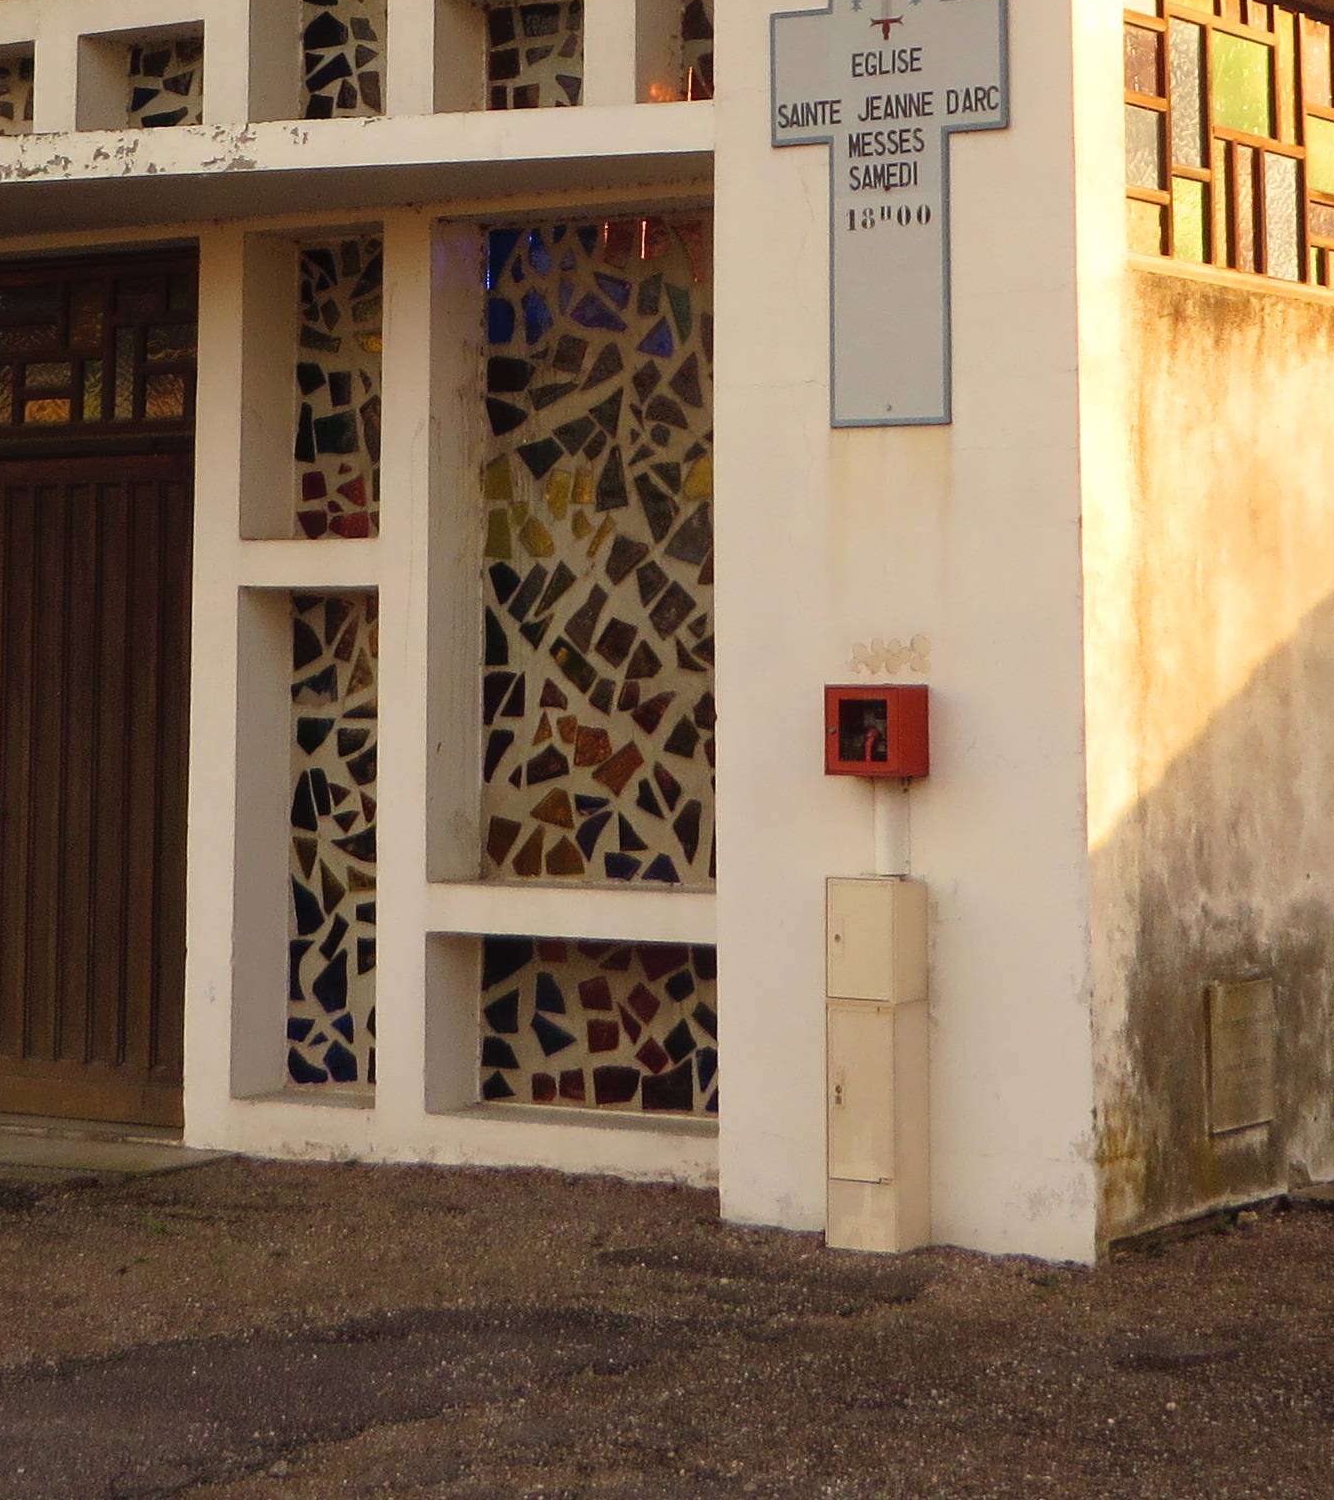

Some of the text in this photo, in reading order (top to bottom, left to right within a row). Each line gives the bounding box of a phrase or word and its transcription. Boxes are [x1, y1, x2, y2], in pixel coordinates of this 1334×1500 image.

[851, 47, 923, 78] EGLISE
[777, 99, 842, 129] SAINTE
[857, 91, 934, 122] JEANNE
[848, 127, 925, 158] MESSES
[849, 161, 918, 190] SAMEDI
